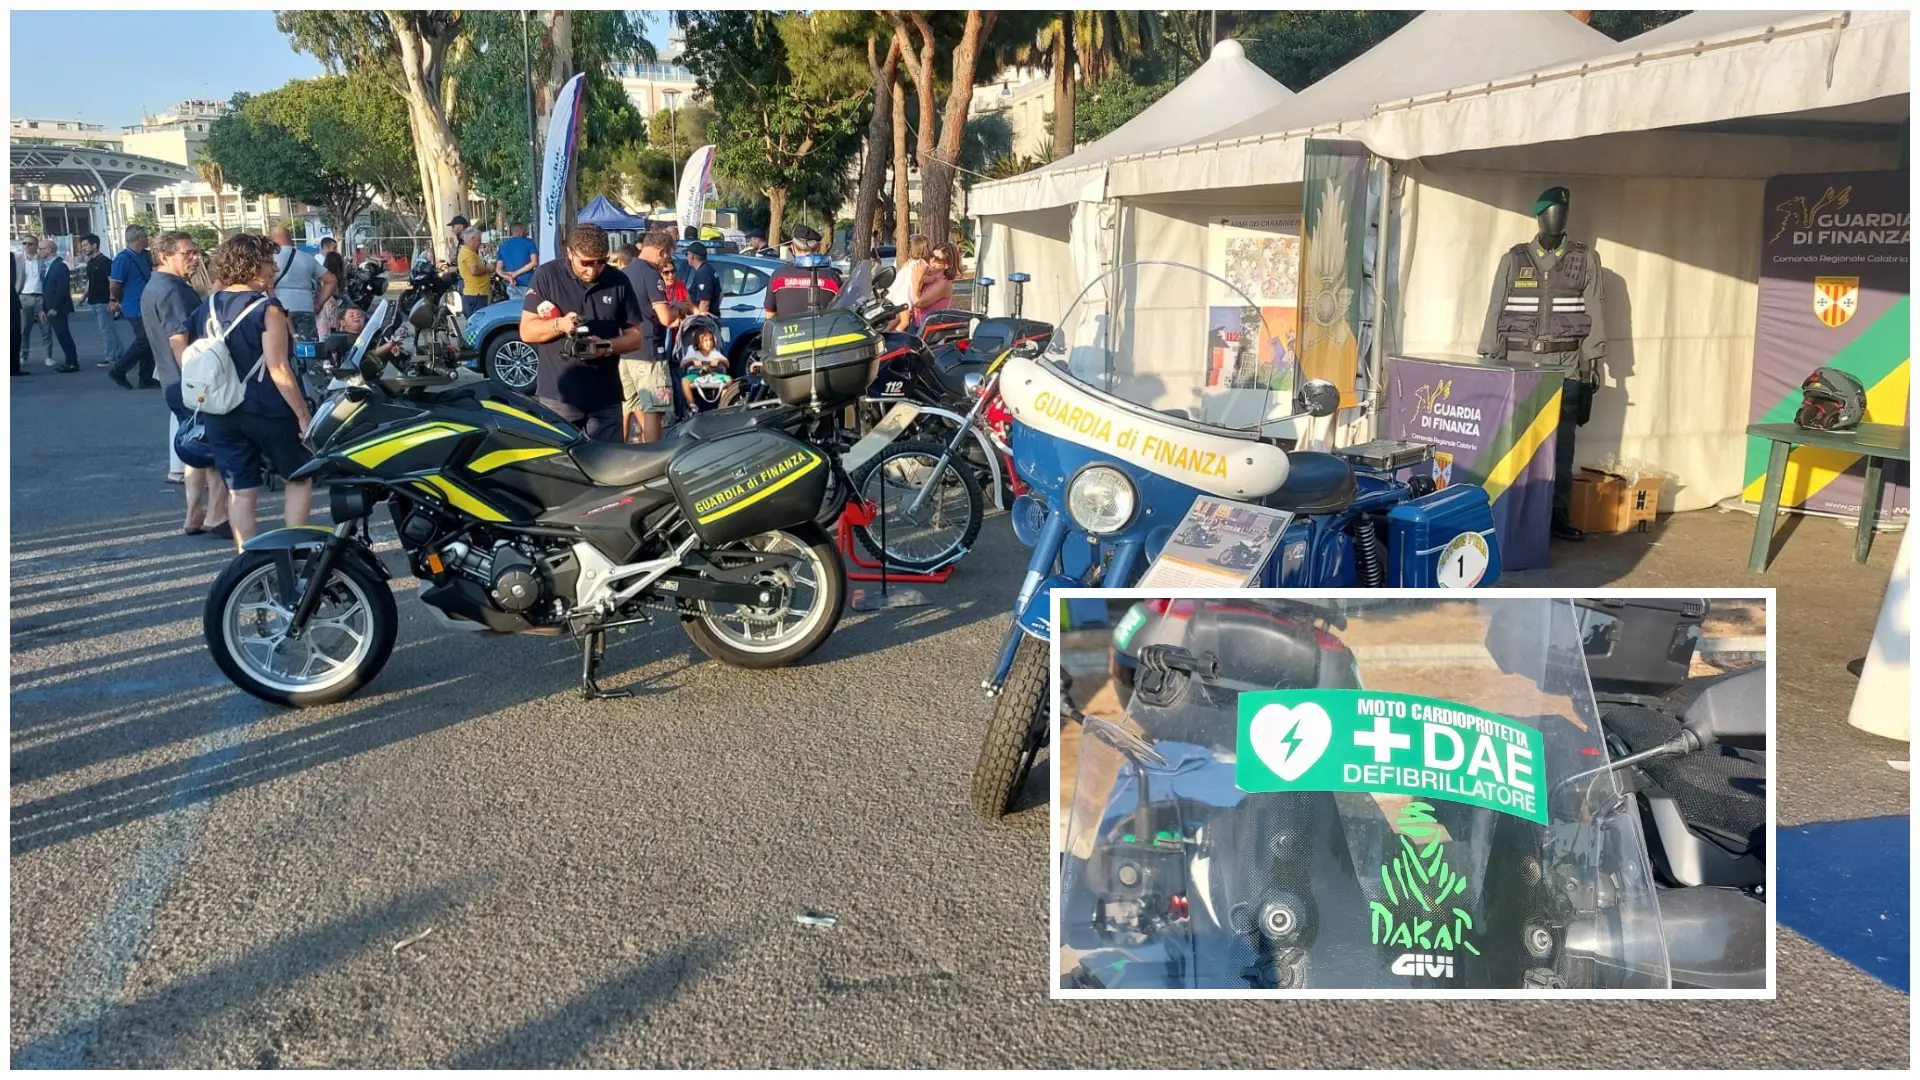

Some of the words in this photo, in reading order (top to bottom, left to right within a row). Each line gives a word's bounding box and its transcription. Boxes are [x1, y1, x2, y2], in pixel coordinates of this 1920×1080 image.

[1793, 231, 1813, 245] DI
[1818, 230, 1910, 245] FINANZA
[1772, 255, 1818, 263] Comando
[1819, 254, 1865, 264] Regionale
[1867, 254, 1908, 263] Calabria
[783, 324, 799, 334] 117
[1226, 331, 1239, 342] 112
[885, 381, 904, 393] 112
[1433, 403, 1481, 422] GUARDIA
[1034, 391, 1112, 443] GUARDIA
[1116, 428, 1140, 451] di
[1141, 435, 1228, 479] FINANZA
[1421, 415, 1432, 428] DI
[1432, 417, 1480, 436] FINANZA
[1411, 432, 1433, 442] Comando
[694, 484, 745, 513] GUARDIA
[747, 476, 759, 490] di
[760, 452, 807, 482] FINANZA
[1457, 554, 1464, 578] 1
[1357, 698, 1406, 719] MOTO
[1411, 703, 1529, 748] CARDIOPROTETTA
[1343, 764, 1537, 814] DEFIBRILLATORE
[1369, 900, 1481, 956] DAKAR
[1391, 953, 1454, 978] GIVI
